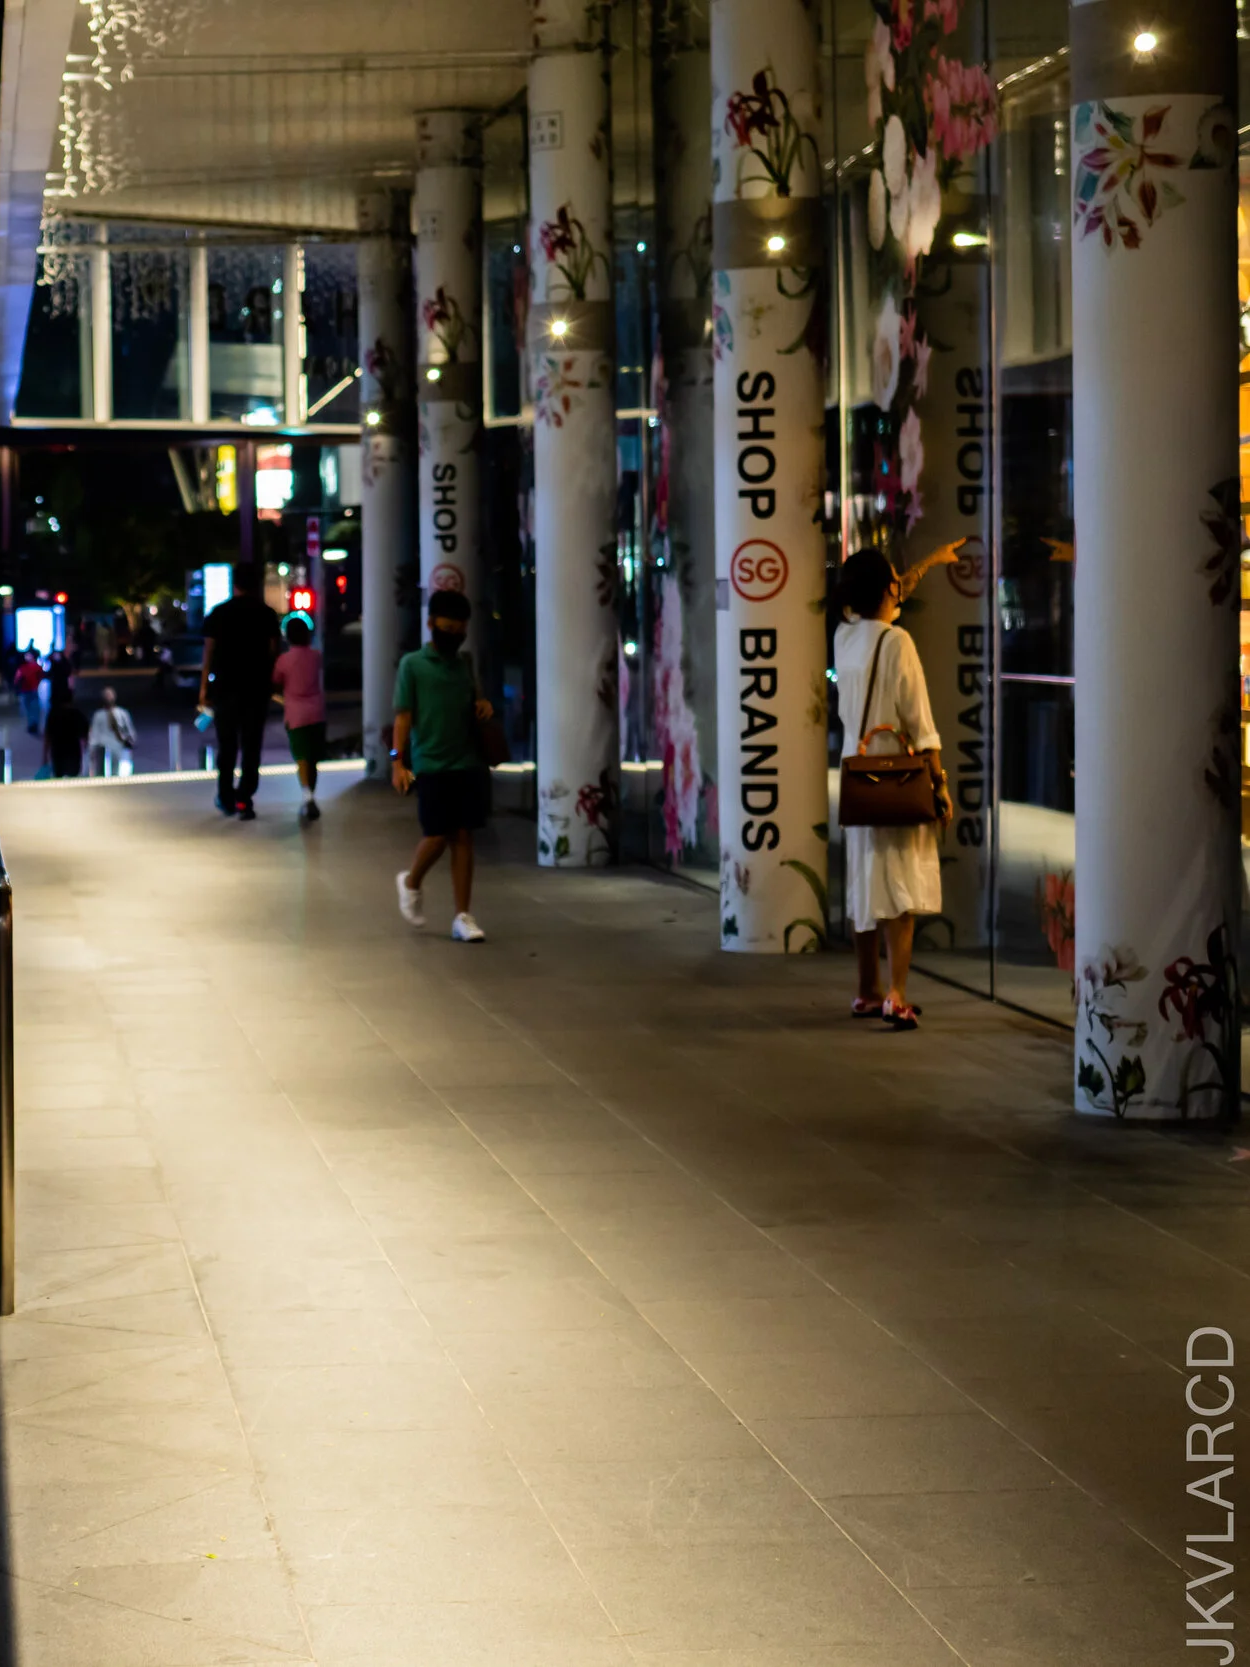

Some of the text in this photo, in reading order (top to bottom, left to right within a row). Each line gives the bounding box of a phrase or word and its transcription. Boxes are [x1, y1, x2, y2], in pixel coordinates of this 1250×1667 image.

[736, 370, 776, 519] SHOP
[432, 463, 457, 553] SHOP
[738, 557, 780, 583] SG
[740, 628, 780, 852] BRANDS
